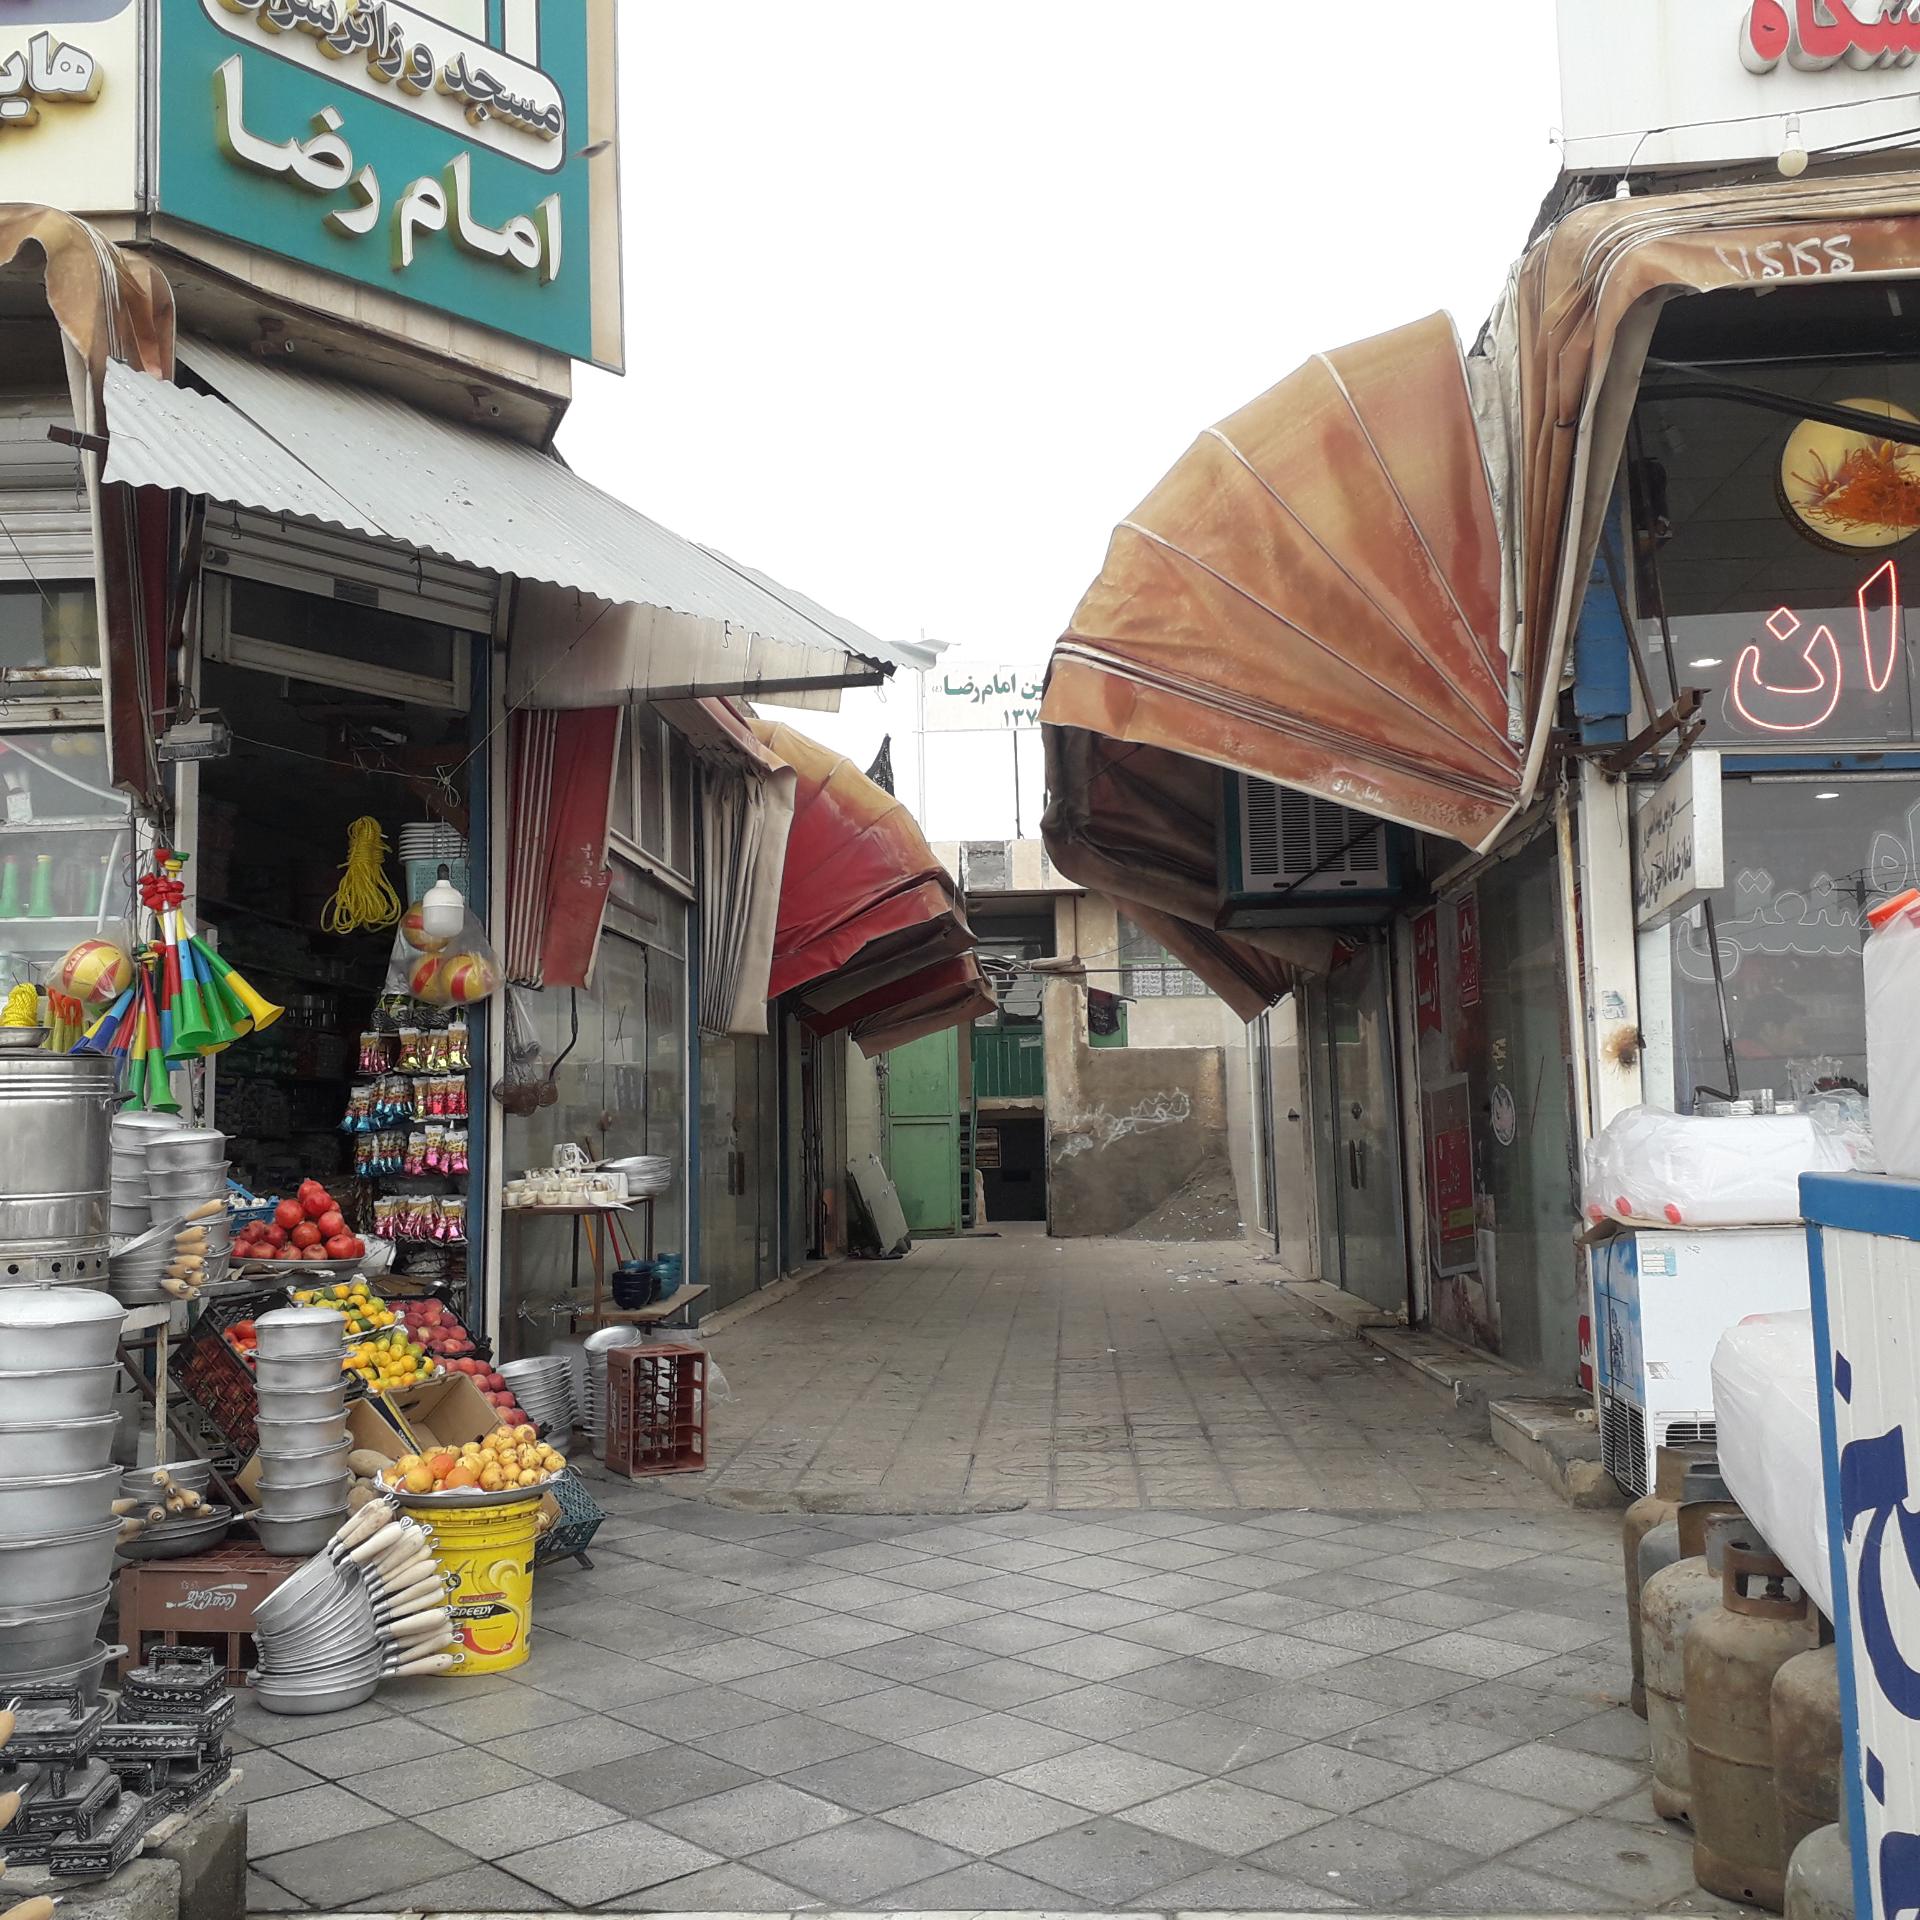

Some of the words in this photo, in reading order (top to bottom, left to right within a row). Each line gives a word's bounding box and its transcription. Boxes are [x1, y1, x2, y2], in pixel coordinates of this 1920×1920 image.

[438, 52, 564, 141] مسجد
[214, 53, 381, 238] رضا
[393, 151, 562, 286] امام
[943, 673, 980, 703] رضا
[981, 673, 1016, 704] امام
[1003, 708, 1039, 728] ۱۳۷
